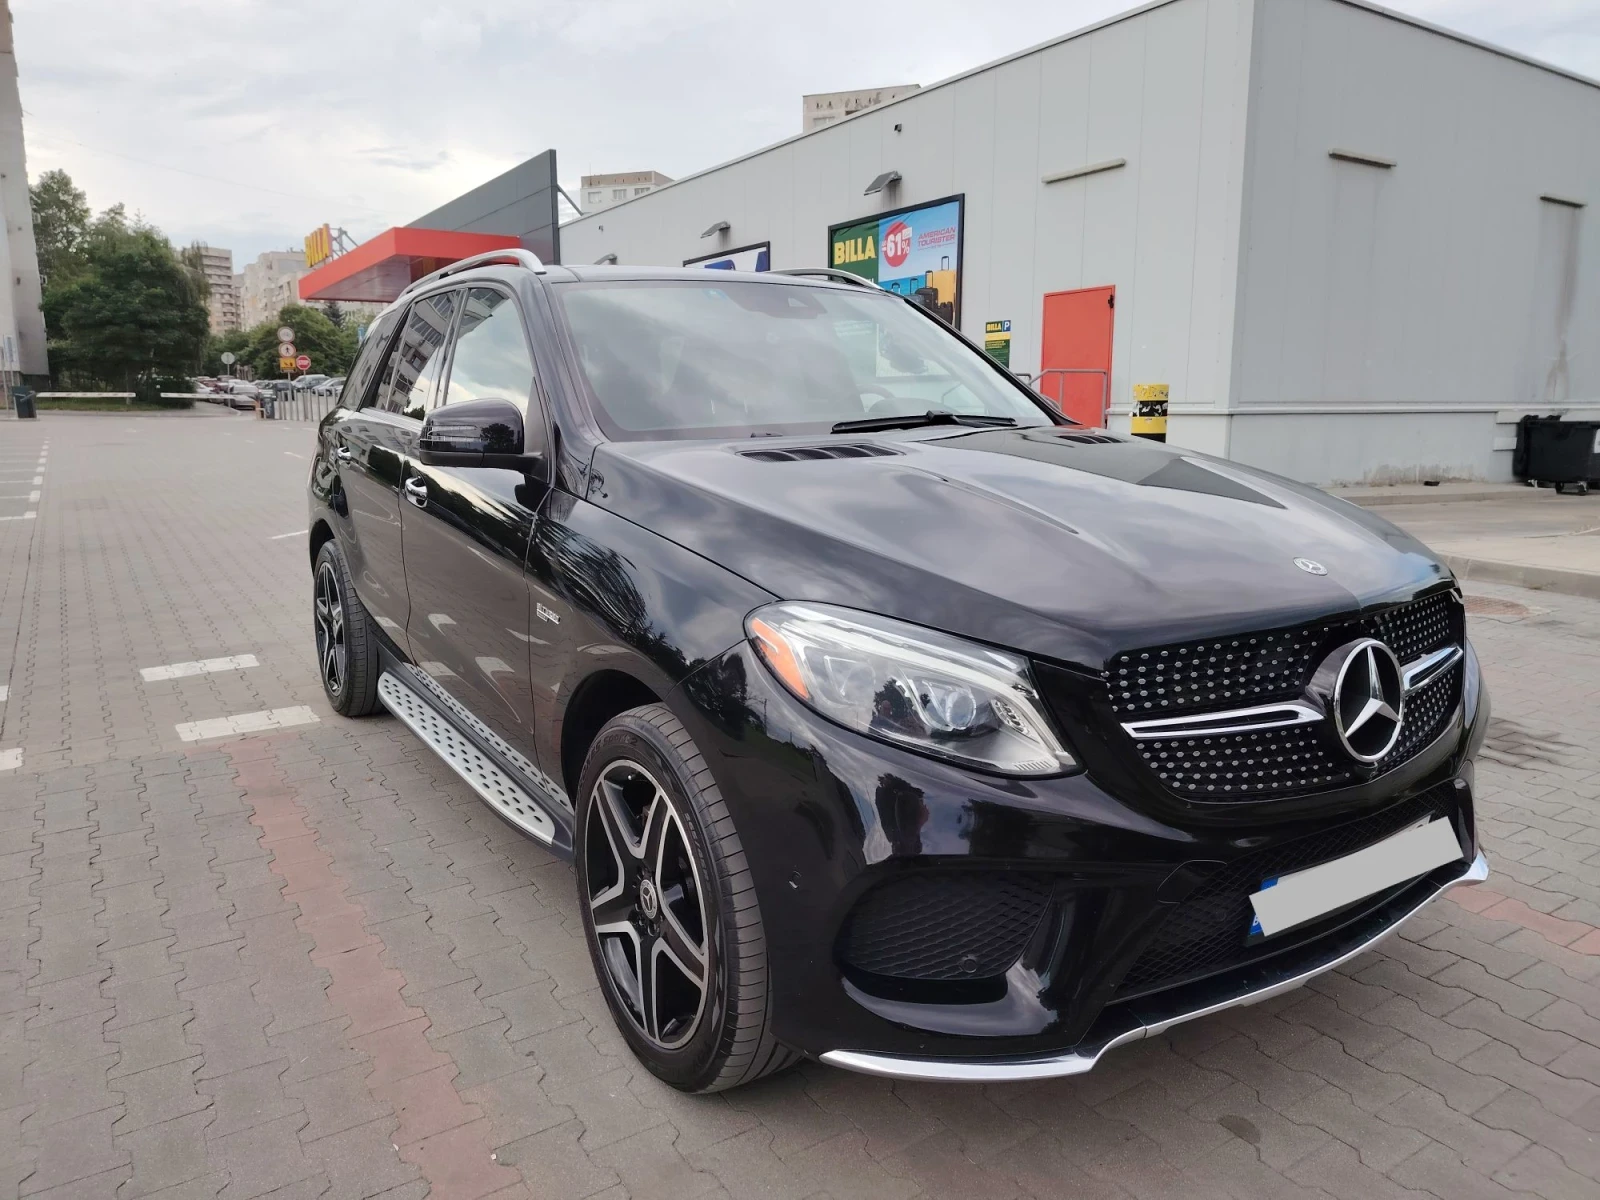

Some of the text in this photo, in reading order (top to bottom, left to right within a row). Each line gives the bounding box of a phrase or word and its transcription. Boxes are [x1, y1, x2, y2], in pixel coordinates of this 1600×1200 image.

[918, 226, 956, 240] AMERICAN
[304, 223, 331, 268] BILLA
[917, 234, 956, 247] TOURISTER
[834, 235, 876, 265] BILLA
[986, 321, 1010, 331] BILLA P
